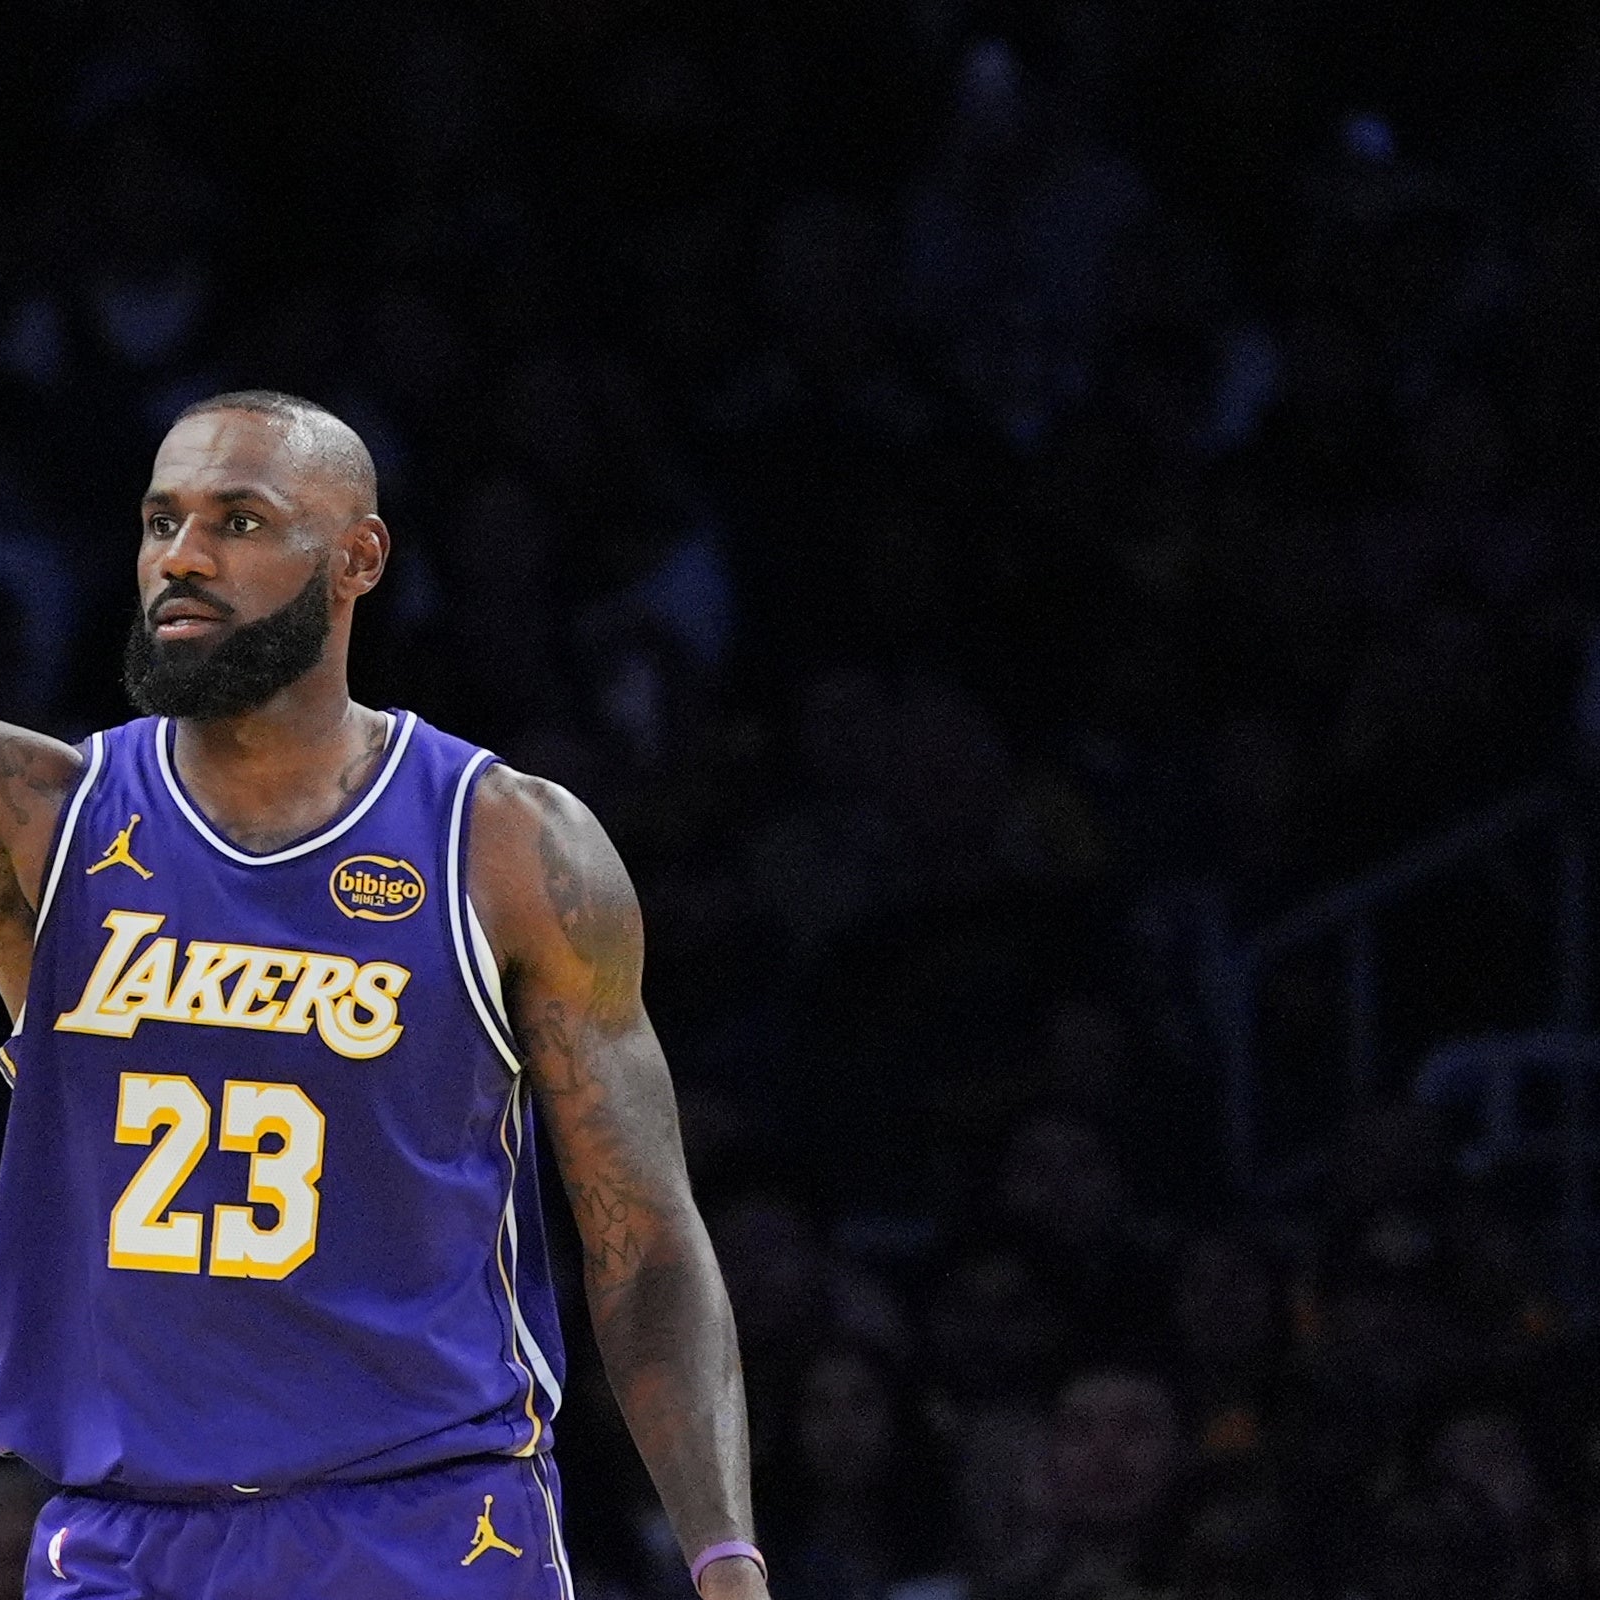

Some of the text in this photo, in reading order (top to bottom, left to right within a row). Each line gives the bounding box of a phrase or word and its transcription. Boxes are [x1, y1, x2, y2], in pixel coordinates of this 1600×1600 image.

[339, 869, 420, 904] bibigo
[53, 909, 412, 1060] LAKERS
[107, 1071, 326, 1281] 23
